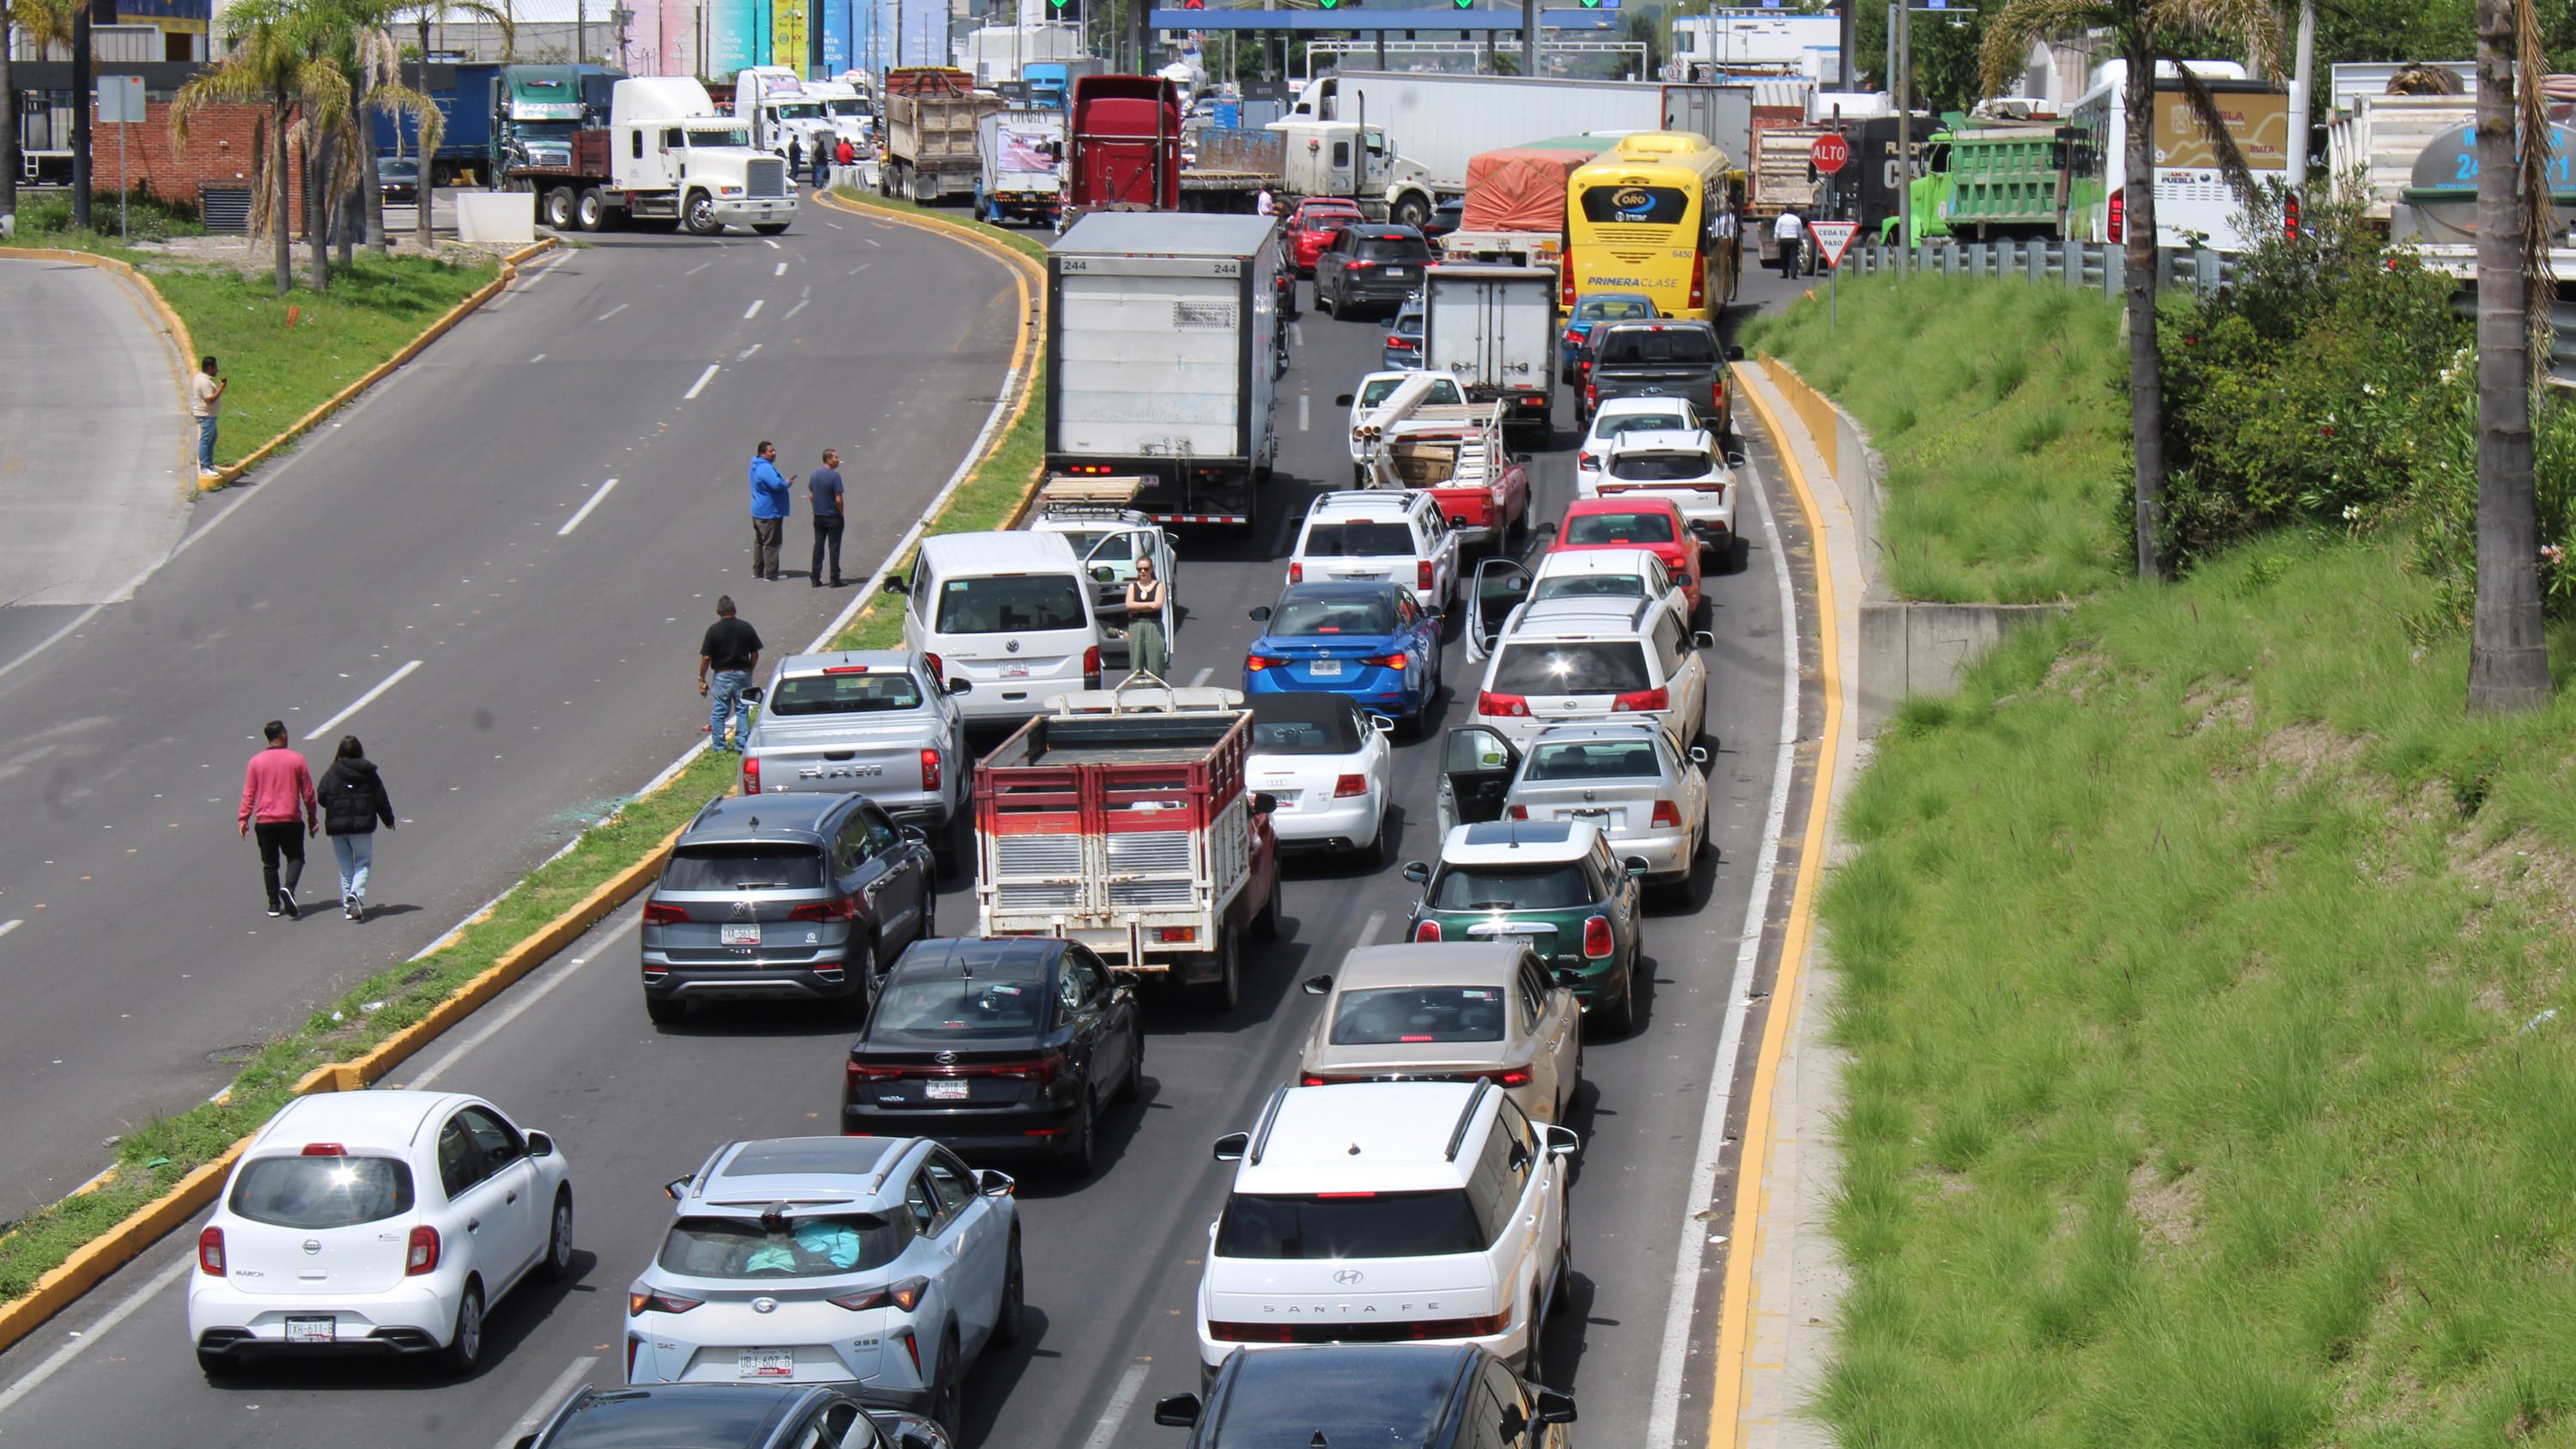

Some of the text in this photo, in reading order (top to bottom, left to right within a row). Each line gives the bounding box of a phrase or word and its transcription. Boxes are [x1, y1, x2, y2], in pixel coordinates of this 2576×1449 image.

[1010, 111, 1050, 125] CHARLY
[1813, 145, 1845, 161] ALTO
[2161, 176, 2196, 185] PUEBLA
[1621, 194, 1646, 205] ORO
[1064, 261, 1087, 271] 244
[1214, 264, 1236, 274] 244
[798, 764, 883, 780] RAM
[235, 1269, 264, 1278] MARCH
[1263, 1301, 1440, 1313] SANTA FE
[740, 1355, 792, 1368] UBJ-607-B
